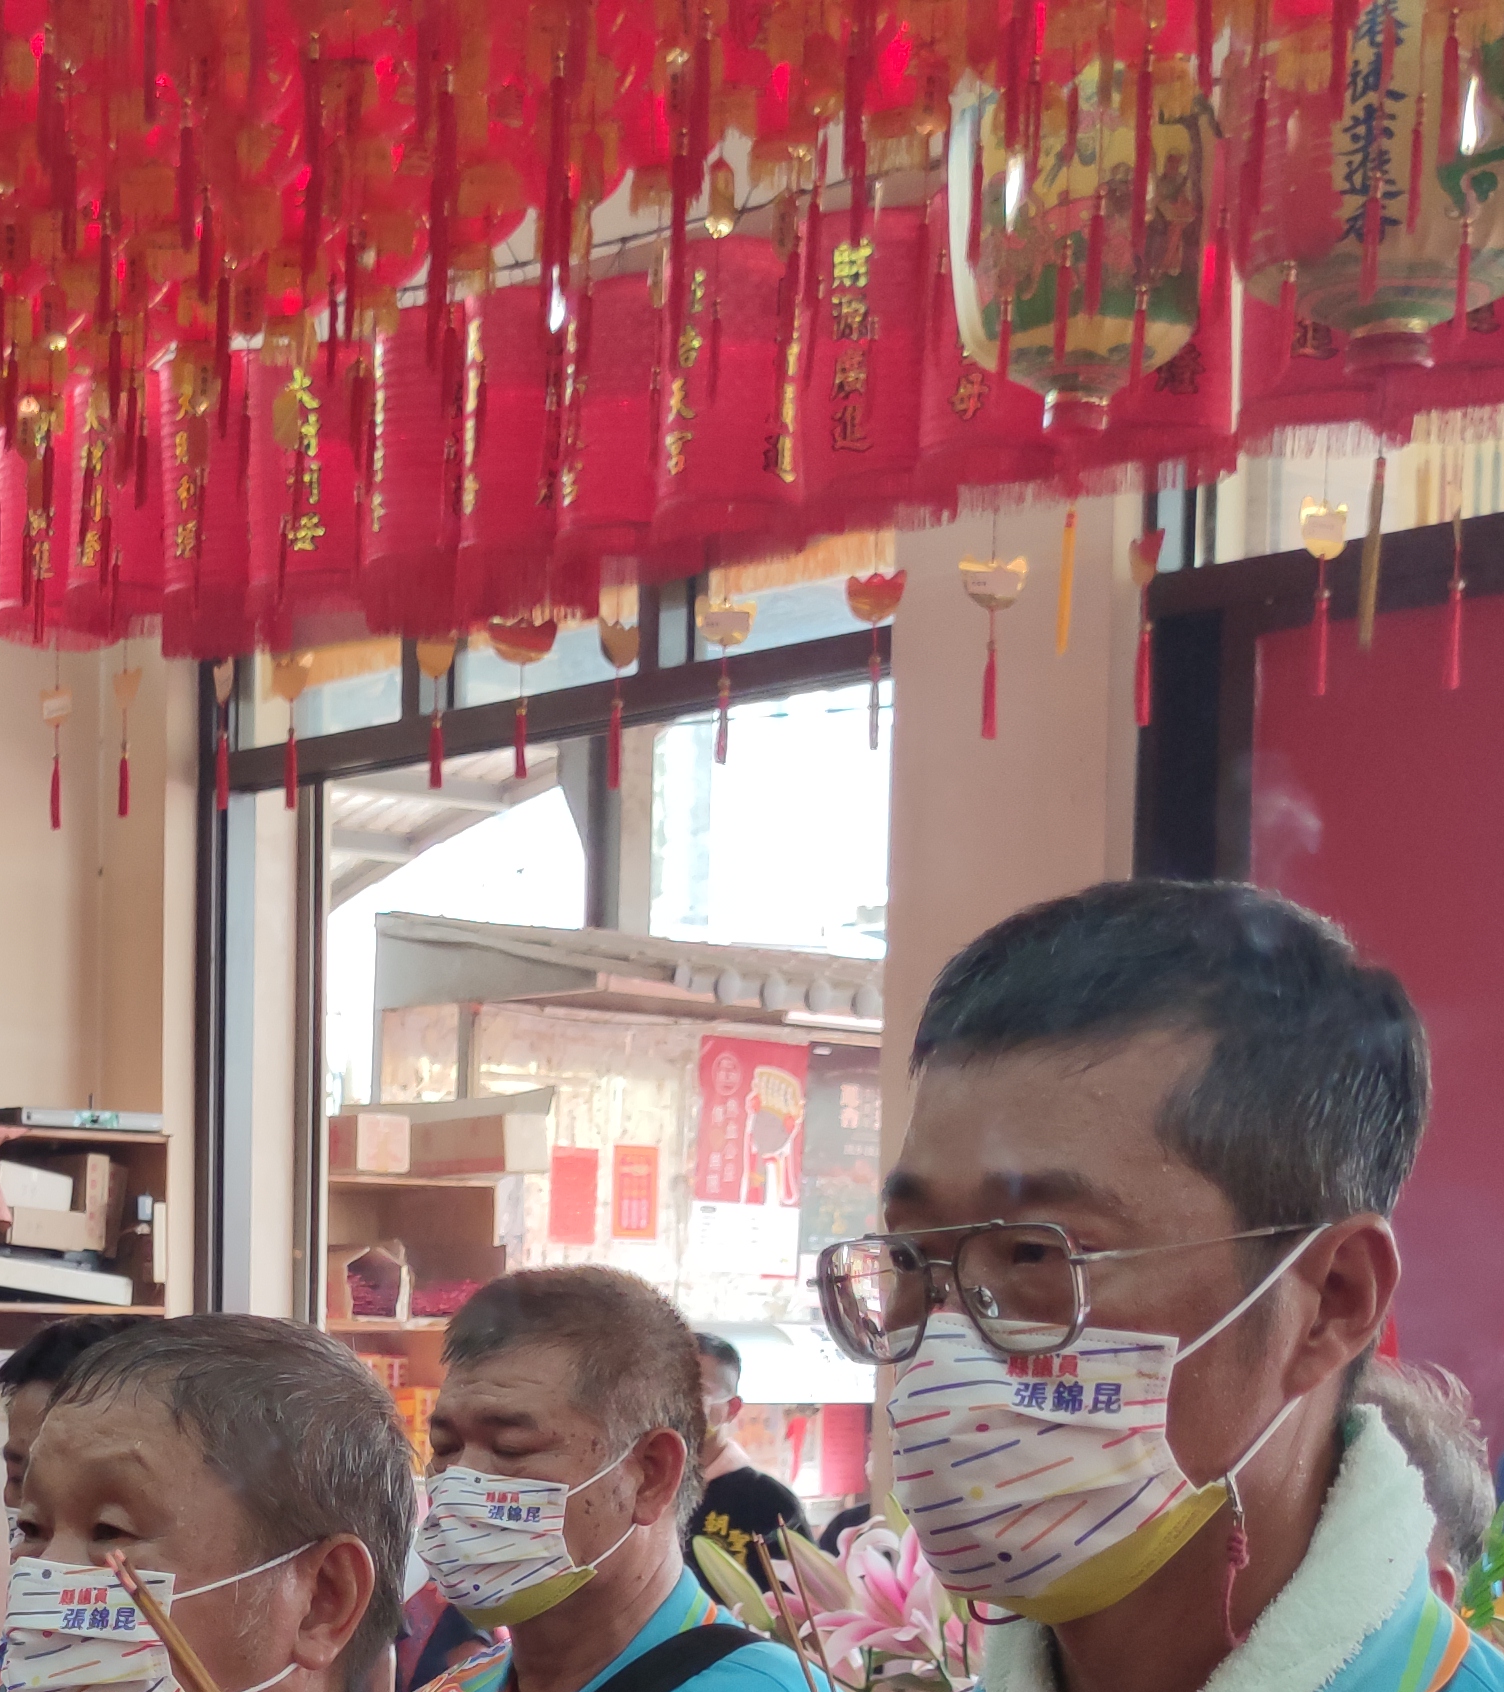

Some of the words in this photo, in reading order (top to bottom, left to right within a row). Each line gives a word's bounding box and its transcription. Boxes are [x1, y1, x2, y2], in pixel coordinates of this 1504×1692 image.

[830, 237, 874, 451] 財源廣進
[1012, 1381, 1122, 1414] 張錦昆
[487, 1504, 541, 1523] 張錦昆
[60, 1606, 137, 1631] 張錦昆
